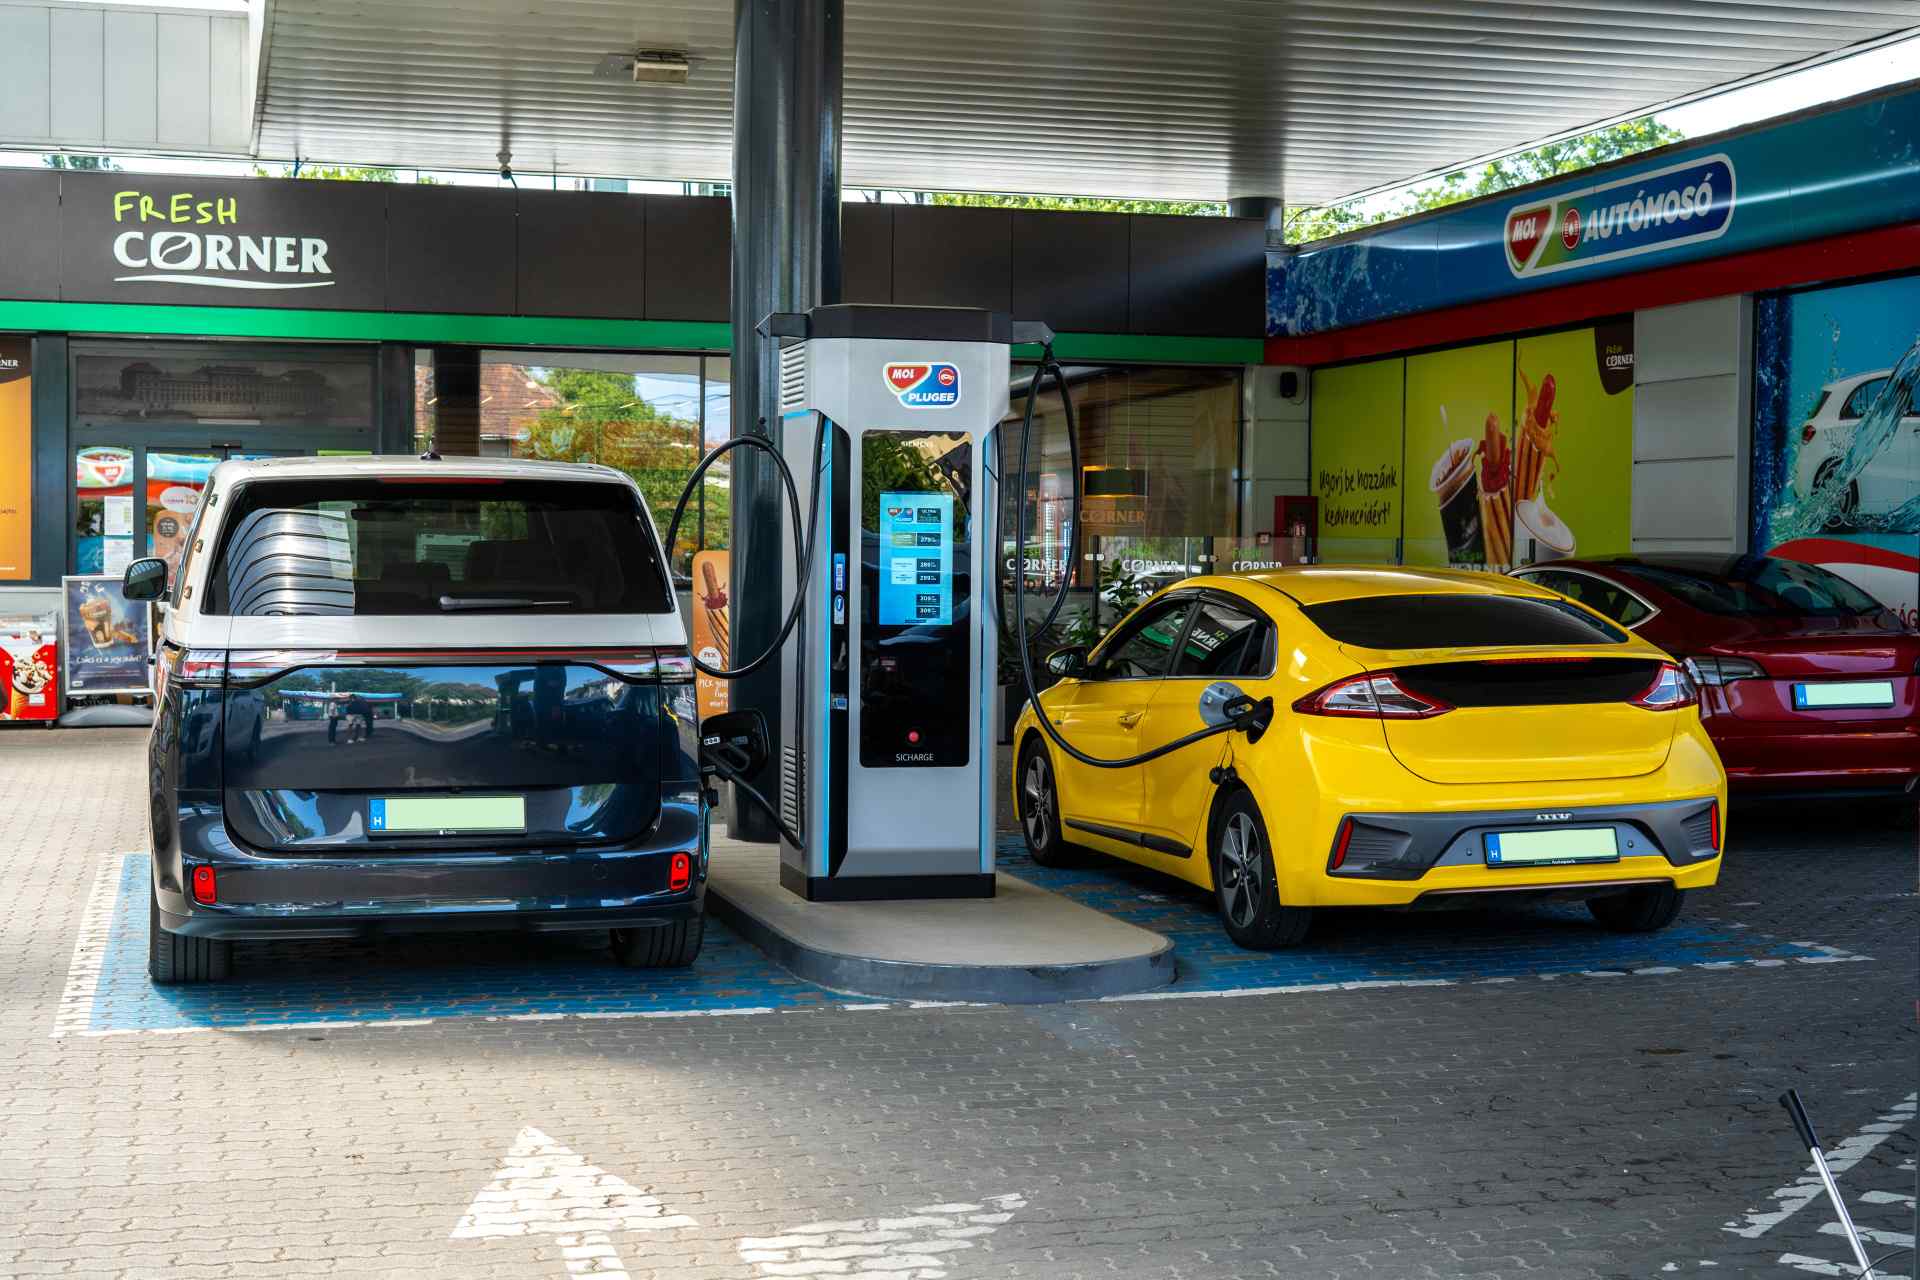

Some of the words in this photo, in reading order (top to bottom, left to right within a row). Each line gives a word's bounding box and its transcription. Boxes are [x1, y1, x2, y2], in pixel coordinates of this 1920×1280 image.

[114, 191, 238, 225] FRESH
[1512, 218, 1537, 242] MOL
[1584, 174, 1713, 242] AUTÓMOSÓ
[113, 230, 332, 274] CORNER
[892, 368, 915, 379] MOL
[908, 392, 954, 402] PLUGEE
[896, 753, 934, 761] SICHARGE
[373, 816, 382, 827] H
[1490, 850, 1498, 858] H
